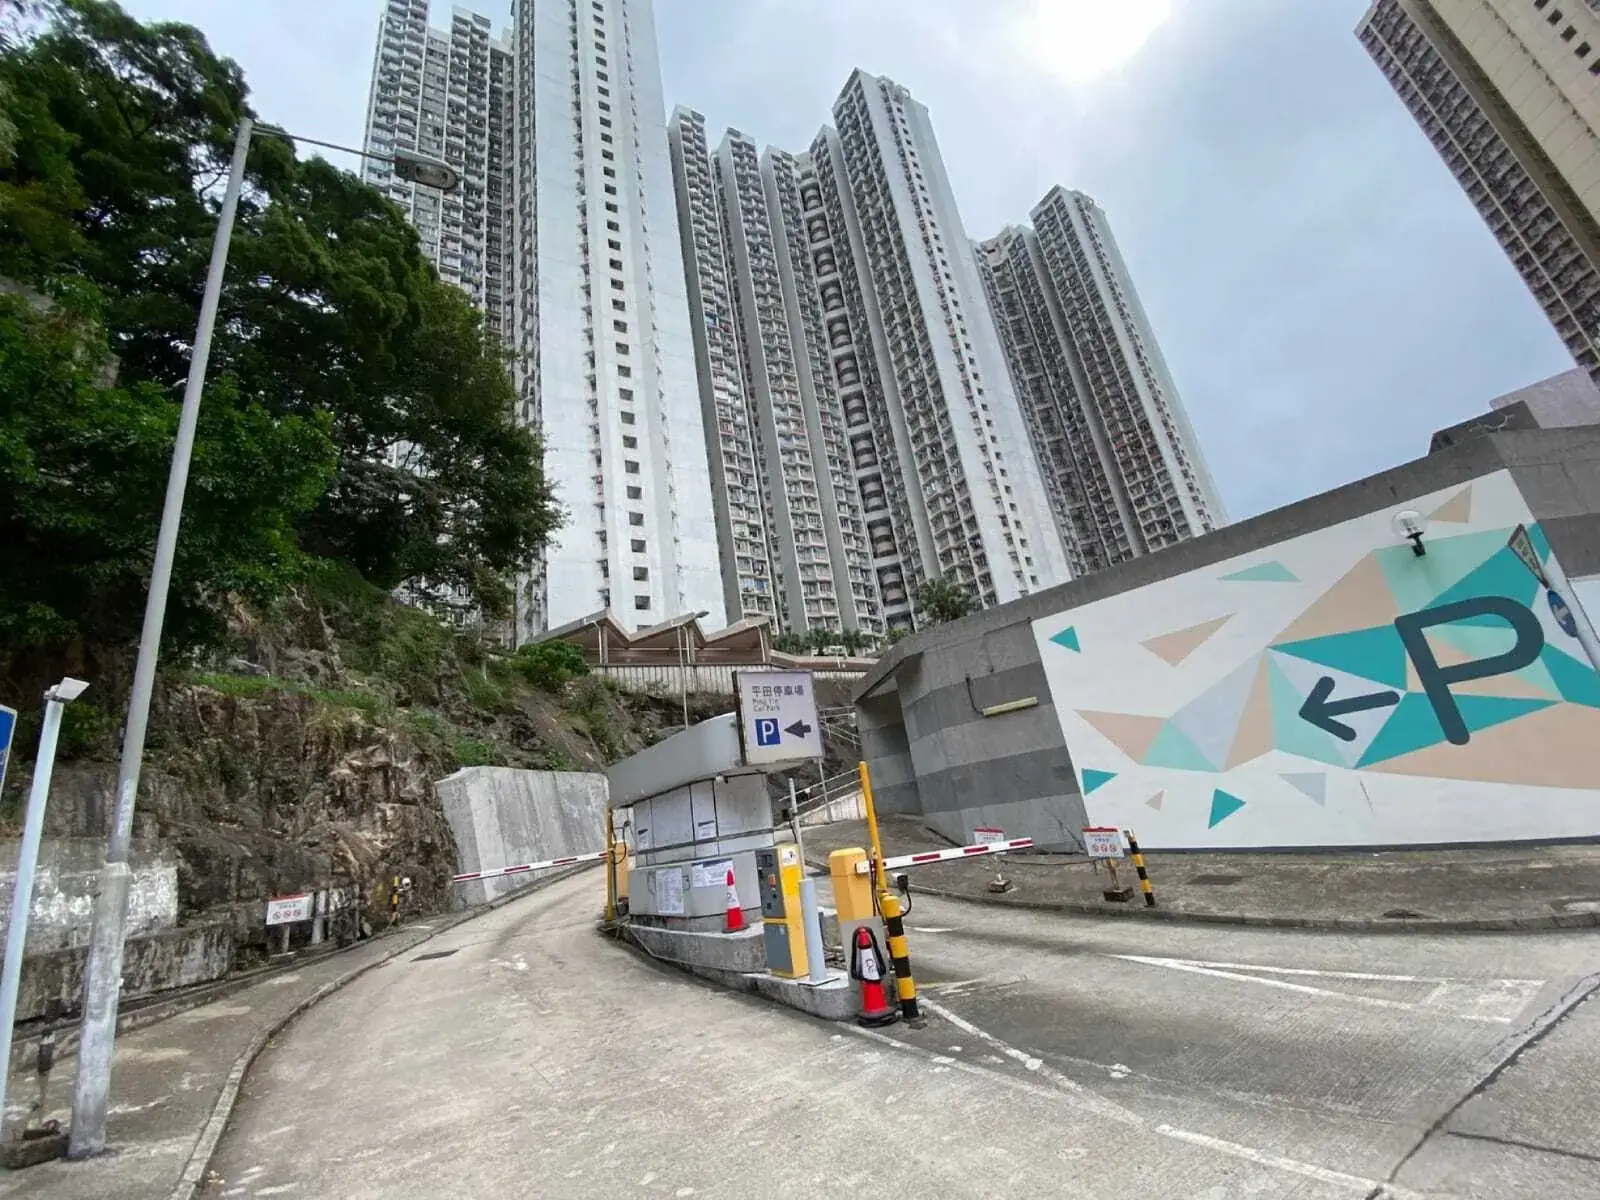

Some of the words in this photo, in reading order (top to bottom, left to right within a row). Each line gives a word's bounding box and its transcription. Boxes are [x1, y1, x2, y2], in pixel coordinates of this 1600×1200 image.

[1394, 595, 1545, 746] P
[752, 685, 804, 697] 平田停車場
[761, 720, 775, 744] P
